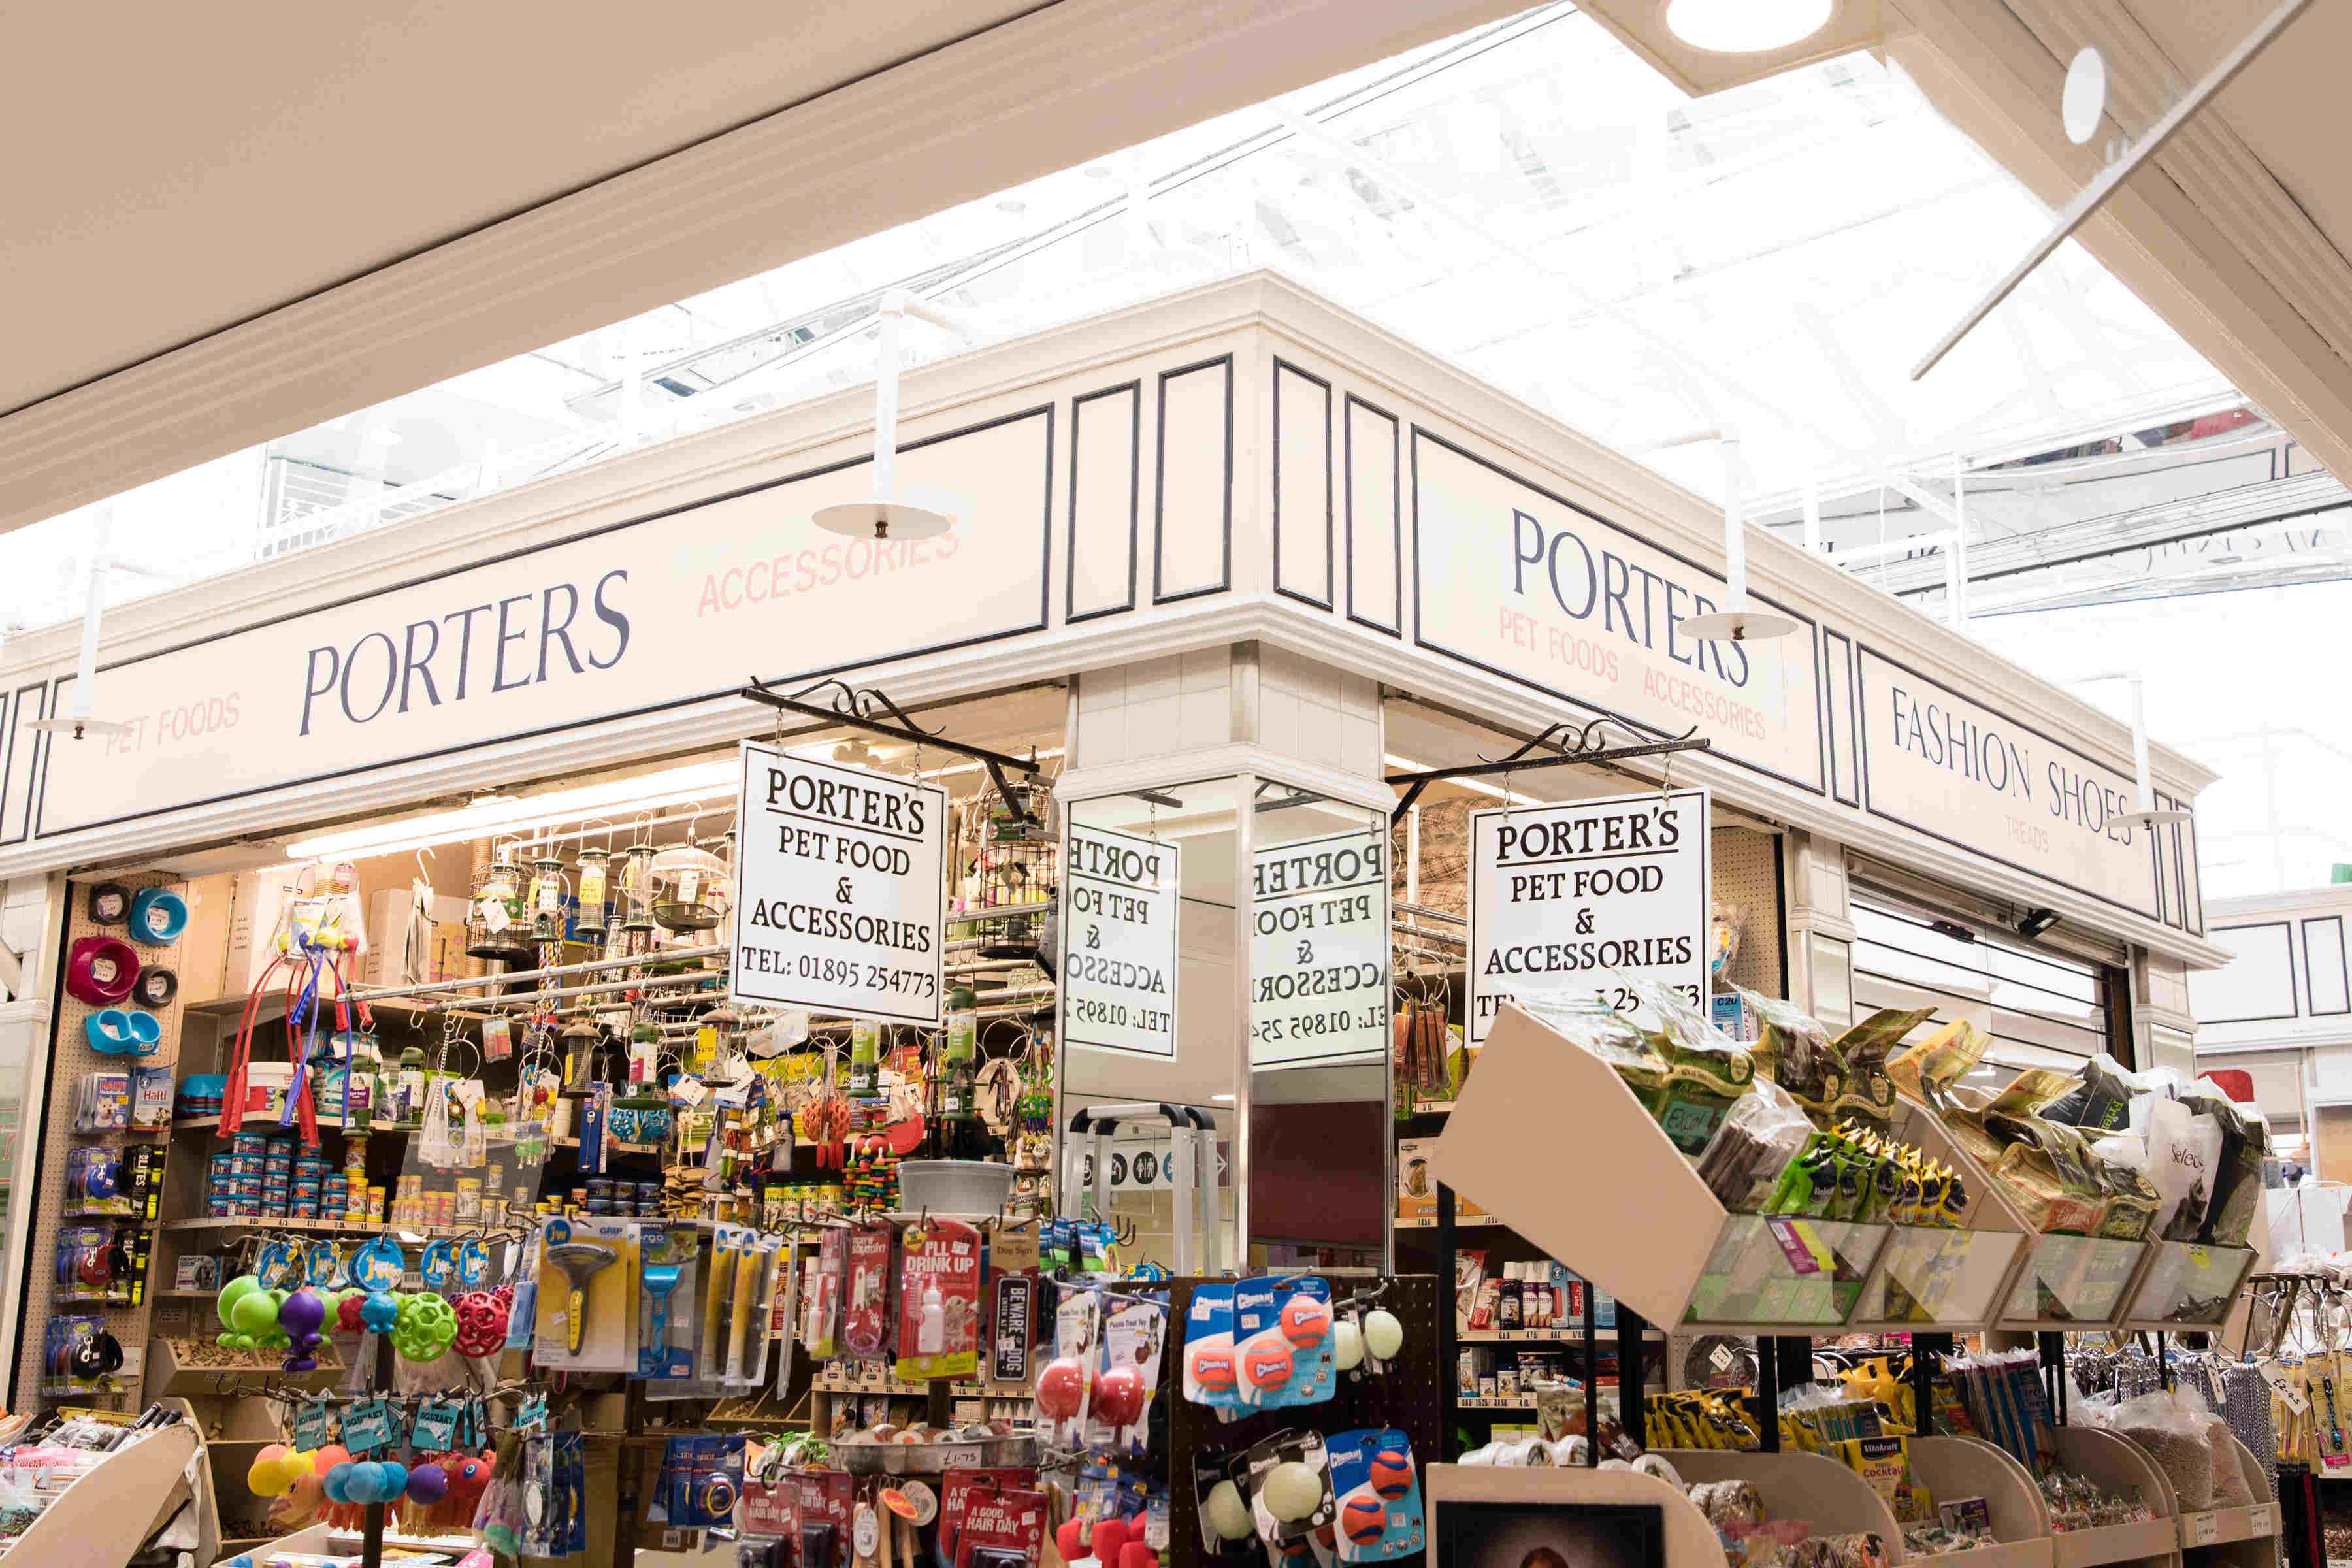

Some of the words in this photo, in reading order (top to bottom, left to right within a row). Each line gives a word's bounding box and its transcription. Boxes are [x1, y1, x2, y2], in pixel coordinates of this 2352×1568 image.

[698, 516, 960, 616] ACCESSORIES
[1512, 508, 1748, 689] PORTERS
[299, 570, 629, 736] PORTERS
[1499, 606, 1537, 652] PET
[1549, 627, 1619, 683] FOODS
[105, 716, 149, 757] PET
[157, 691, 240, 746] FOODS
[1644, 666, 1766, 740] ACCESSORIES
[1892, 686, 2032, 802] FASHION
[2048, 762, 2132, 846] SHOES
[767, 768, 924, 835] PORTER'S
[779, 826, 828, 860] PET
[836, 837, 910, 876] FOOD
[1496, 806, 1679, 860] PORTER'S
[2004, 815, 2050, 852] TREADS
[836, 877, 853, 904] &
[1511, 873, 1565, 902] PET
[1573, 866, 1663, 898] FOOD
[750, 899, 930, 953] ACCESSORIES
[1575, 908, 1595, 934] &
[742, 946, 791, 975] TEL:
[799, 955, 859, 987] 01895
[866, 965, 934, 998] 254773
[1484, 936, 1691, 975] ACCESSORIES
[143, 1090, 167, 1101] Halti
[906, 1256, 952, 1273] DRINK
[954, 1256, 975, 1273] UP
[925, 1241, 950, 1257] I'LL
[1009, 1286, 1026, 1333] BEWARE
[1006, 1348, 1022, 1371] DOG
[1863, 1465, 1904, 1478] Cocktail
[966, 1516, 994, 1532] HAIR
[995, 1517, 1020, 1536] DAY
[971, 1505, 978, 1517] A
[979, 1507, 1004, 1518] GOOD
